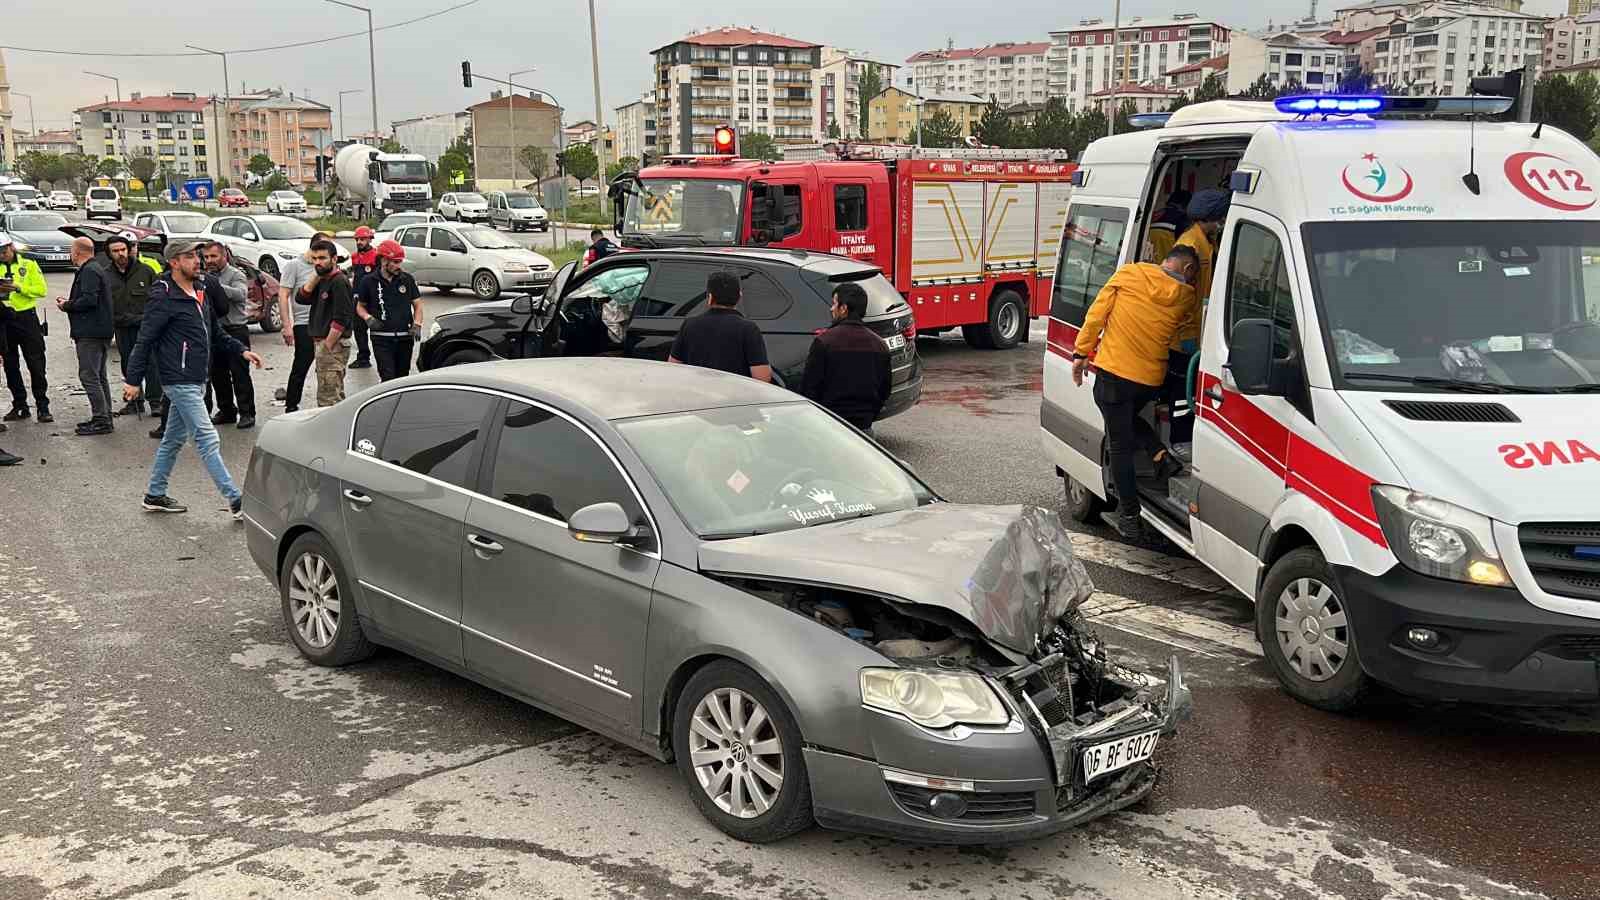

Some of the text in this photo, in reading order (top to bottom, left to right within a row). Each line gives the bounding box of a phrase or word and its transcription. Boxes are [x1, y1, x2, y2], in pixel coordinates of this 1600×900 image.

[1527, 168, 1593, 192] 112
[787, 505, 835, 525] Yusuf
[1087, 732, 1158, 776] 06 BF 6027
